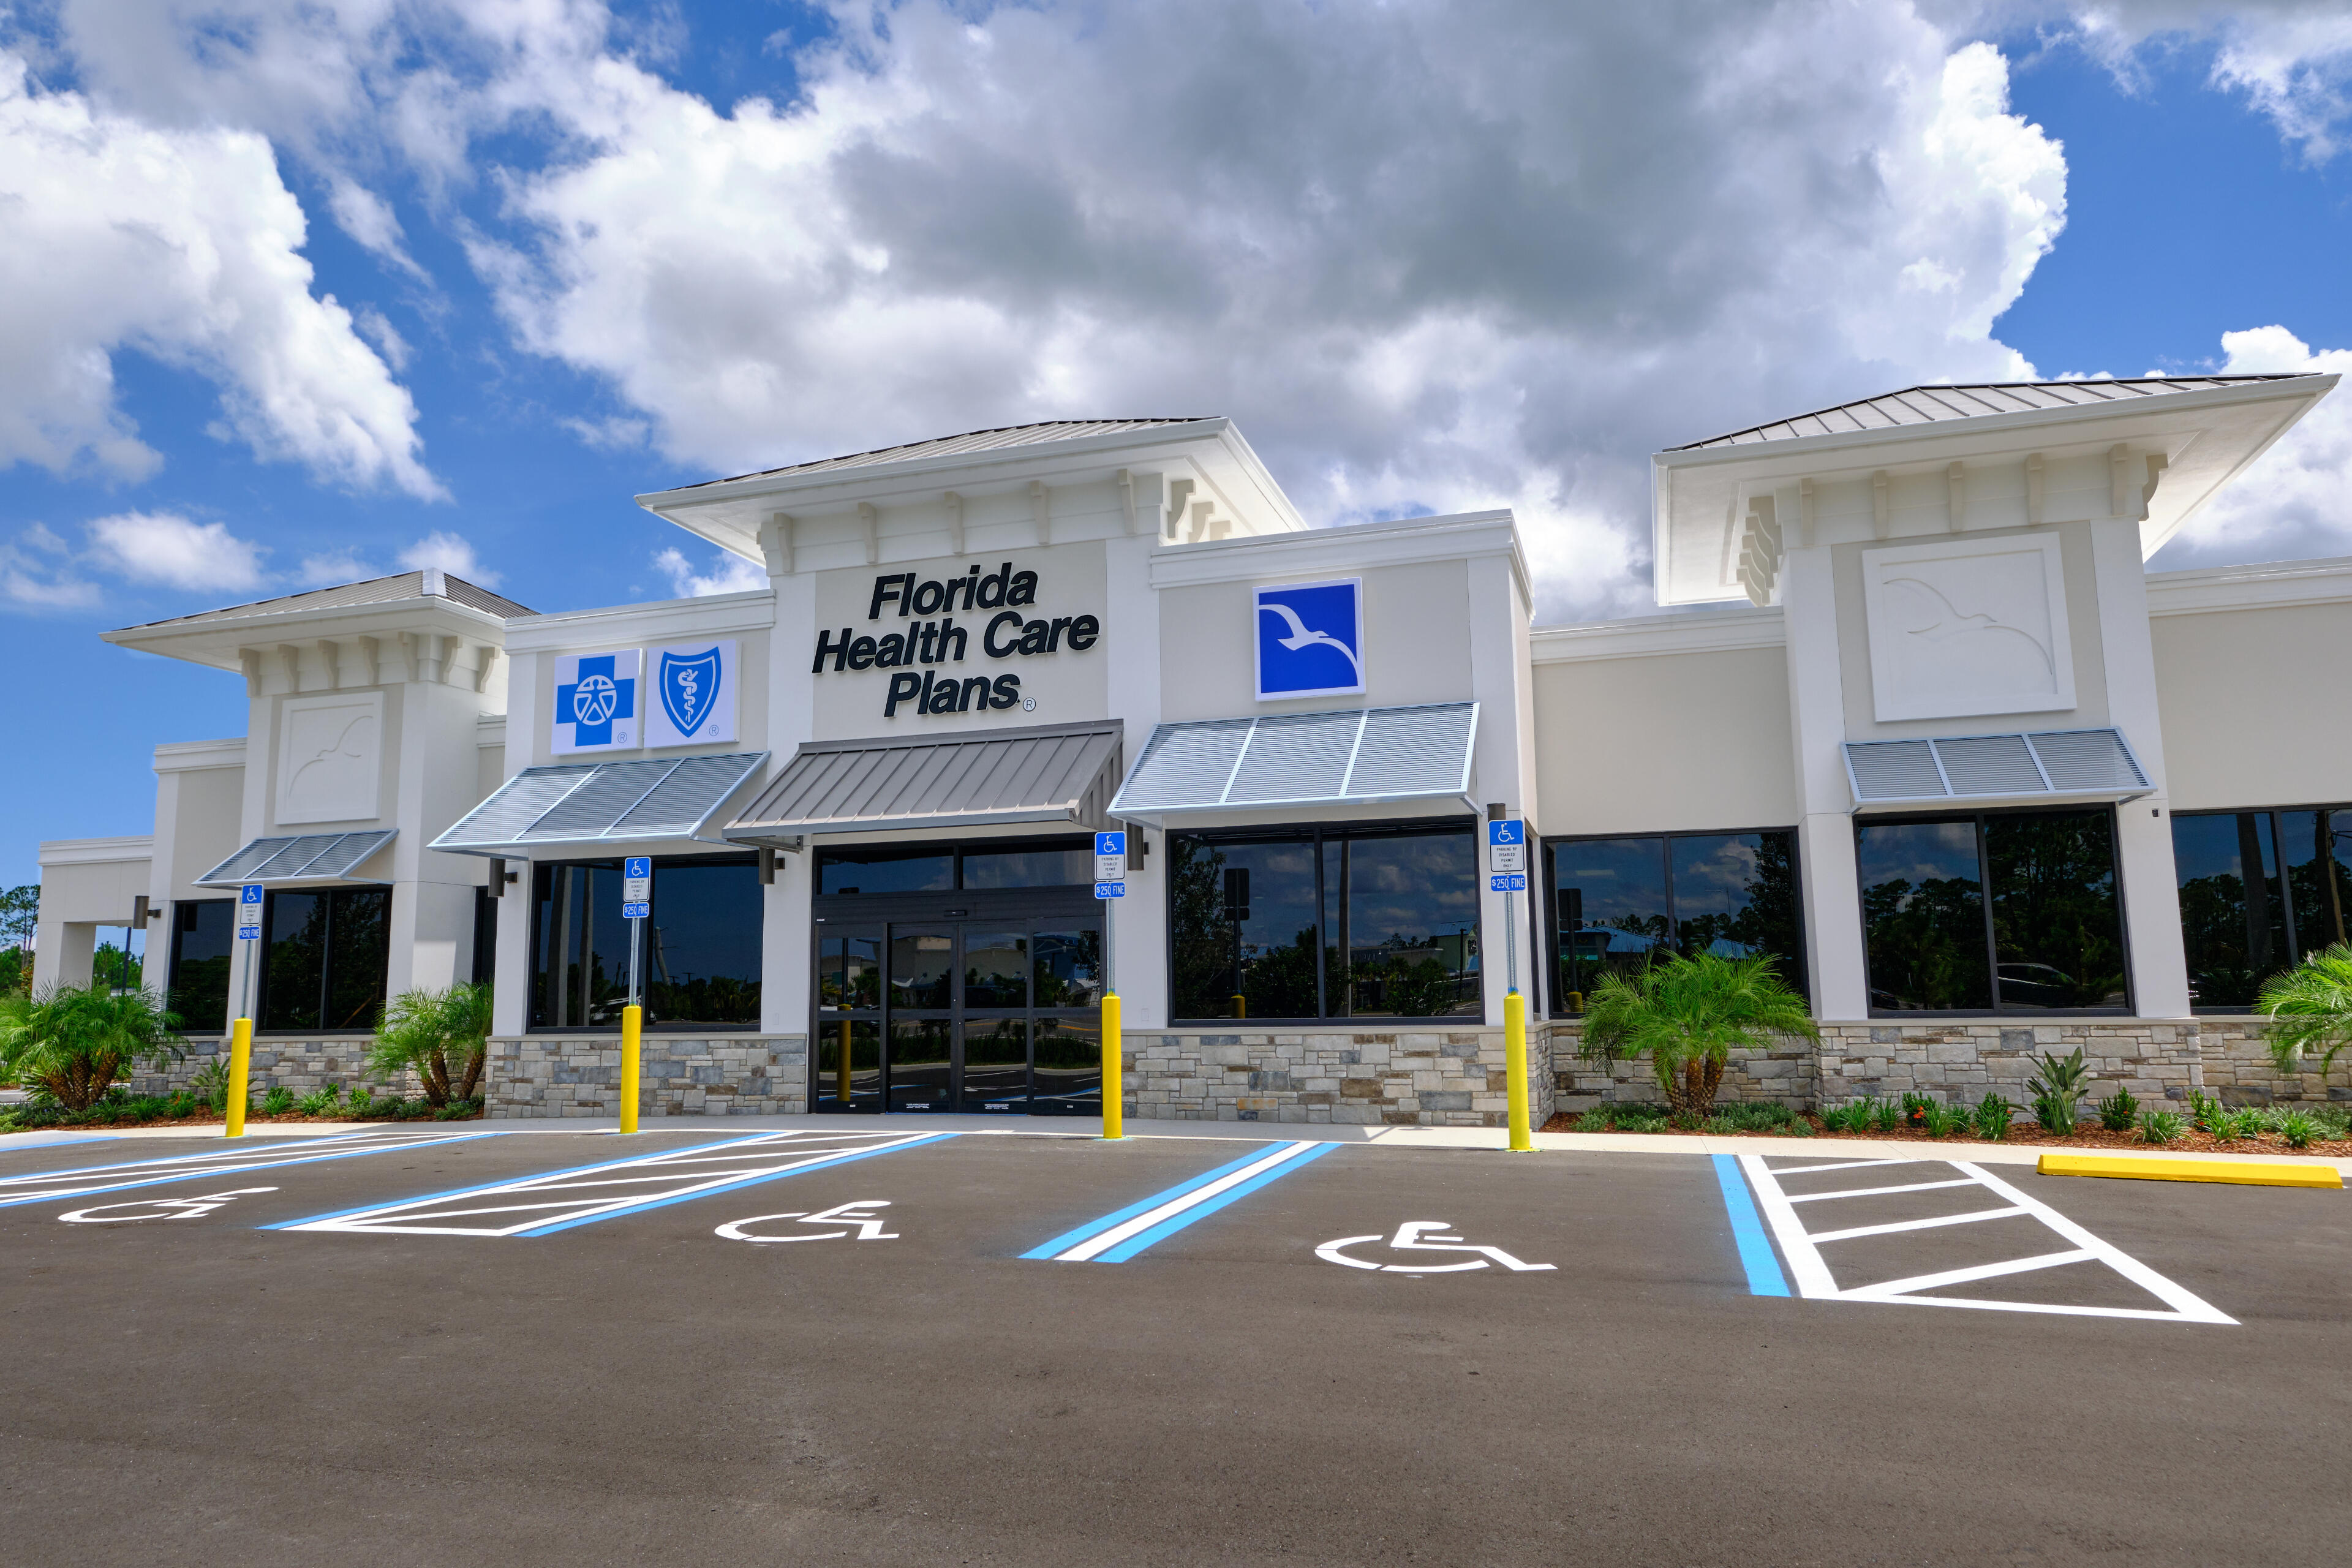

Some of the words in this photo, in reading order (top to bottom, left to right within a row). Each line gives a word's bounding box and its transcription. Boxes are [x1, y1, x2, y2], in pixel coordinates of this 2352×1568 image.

[869, 562, 1038, 620] Florida
[812, 617, 968, 674] Health
[983, 611, 1100, 658] Care
[1491, 878, 1509, 889] $250
[1511, 878, 1525, 888] FINE
[1096, 886, 1111, 895] $250
[1113, 885, 1125, 895] FINE
[239, 929, 251, 938] $250
[251, 929, 260, 937] FINE
